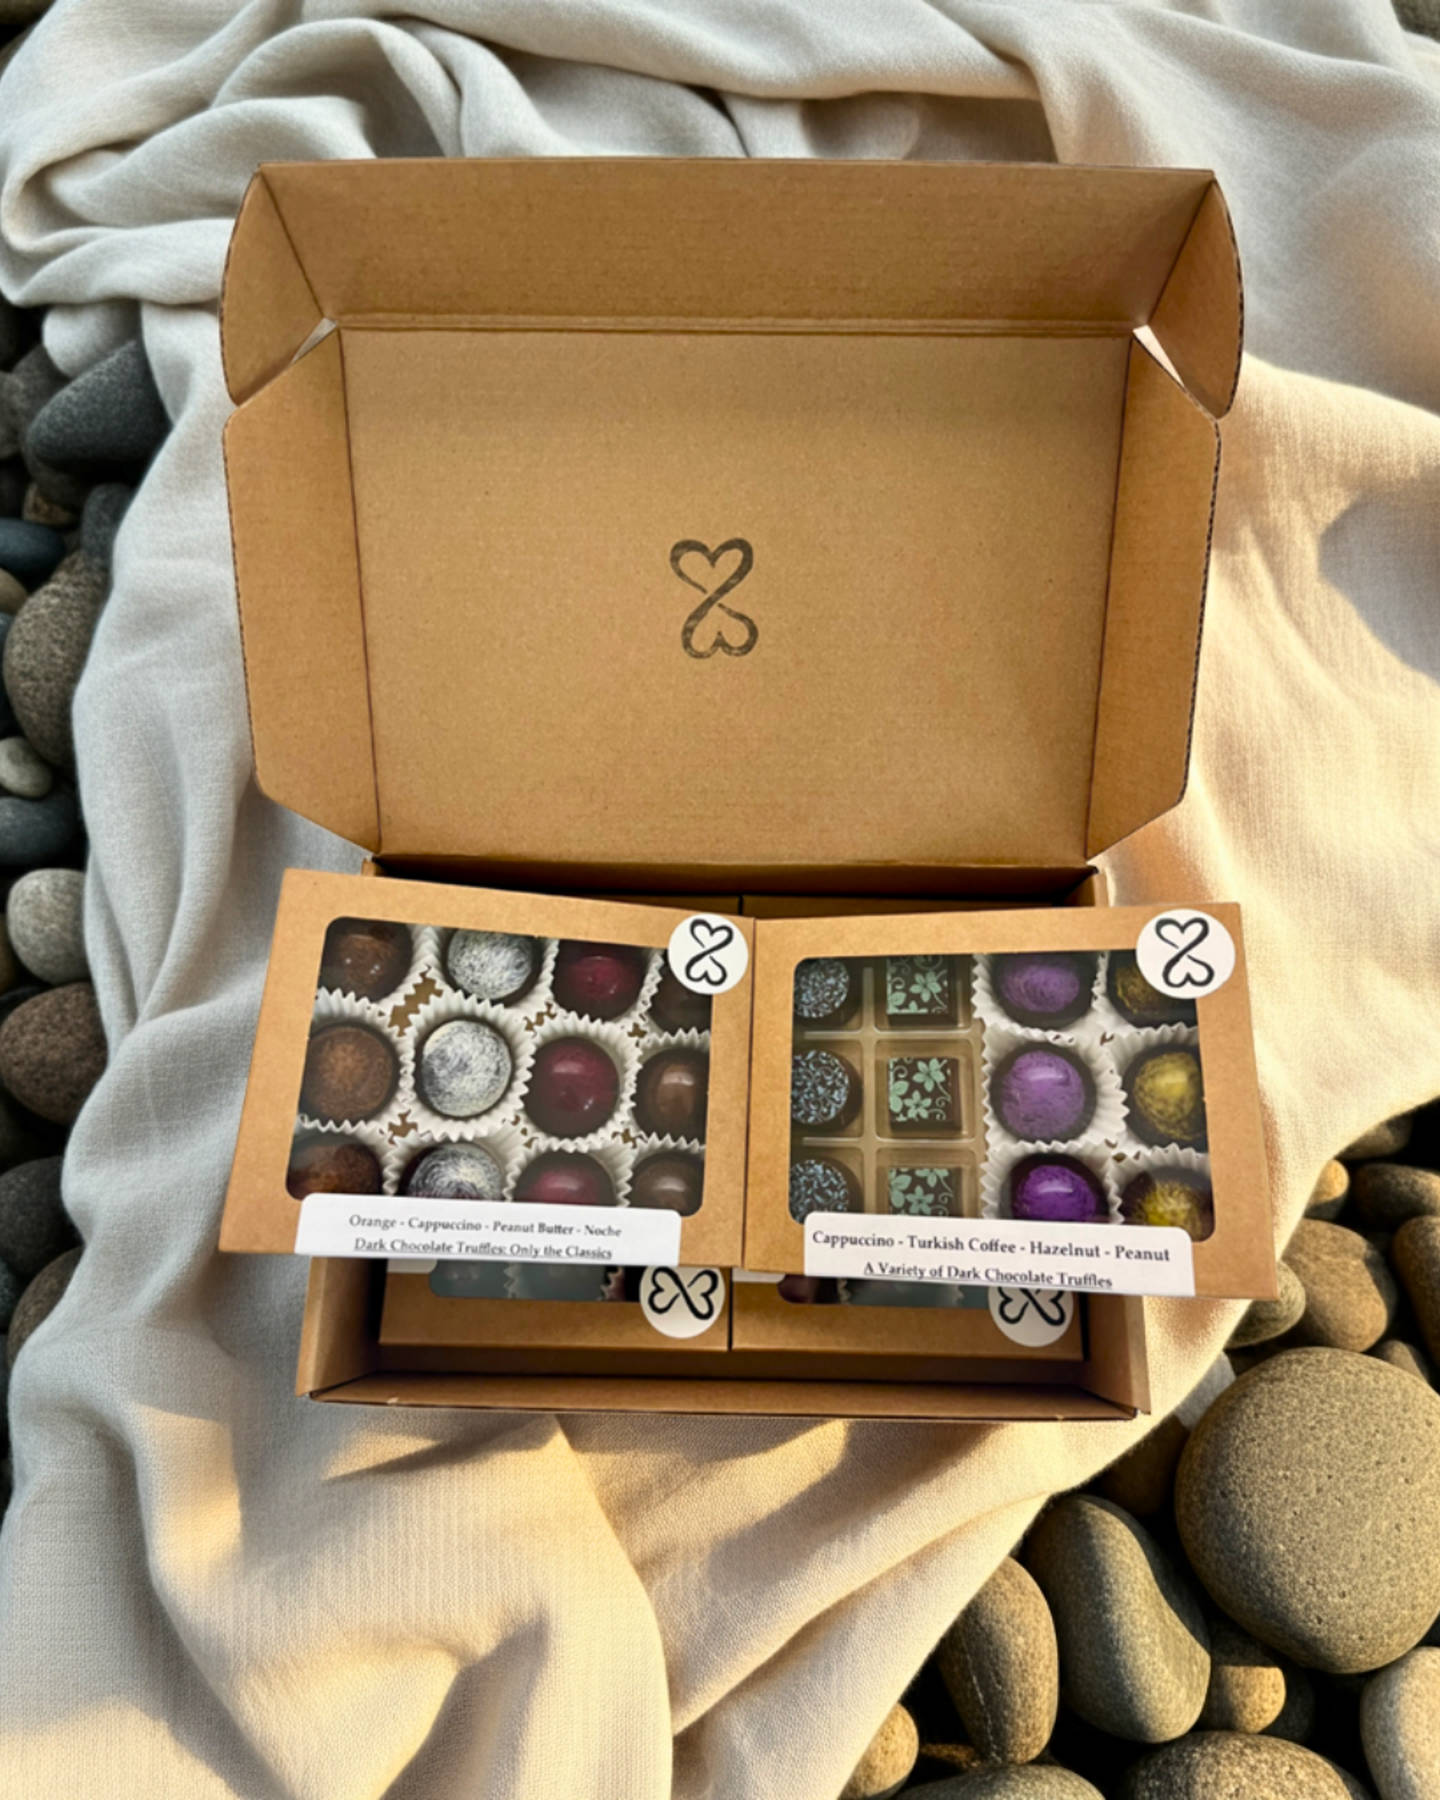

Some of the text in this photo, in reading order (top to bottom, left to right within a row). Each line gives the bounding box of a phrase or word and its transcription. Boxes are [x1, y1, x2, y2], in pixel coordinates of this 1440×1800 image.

[349, 1214, 396, 1230] Orange
[408, 1217, 482, 1232] Cappuccino
[493, 1221, 534, 1233] Peanut
[538, 1222, 574, 1235] Butter
[584, 1224, 621, 1236] Noche
[354, 1238, 385, 1250] Dark
[390, 1239, 452, 1252] Chocolate
[510, 1244, 539, 1258] Only
[544, 1246, 562, 1257] the
[565, 1246, 612, 1259] Classics
[813, 1231, 894, 1248] Cappuccino
[908, 1235, 964, 1250] Turkish
[969, 1237, 1016, 1253] Coffee
[1030, 1241, 1100, 1258] Hazelnut
[1115, 1245, 1170, 1261] Peanut
[864, 1262, 1113, 1288] A Variety of Dark Chocolate Truffles
